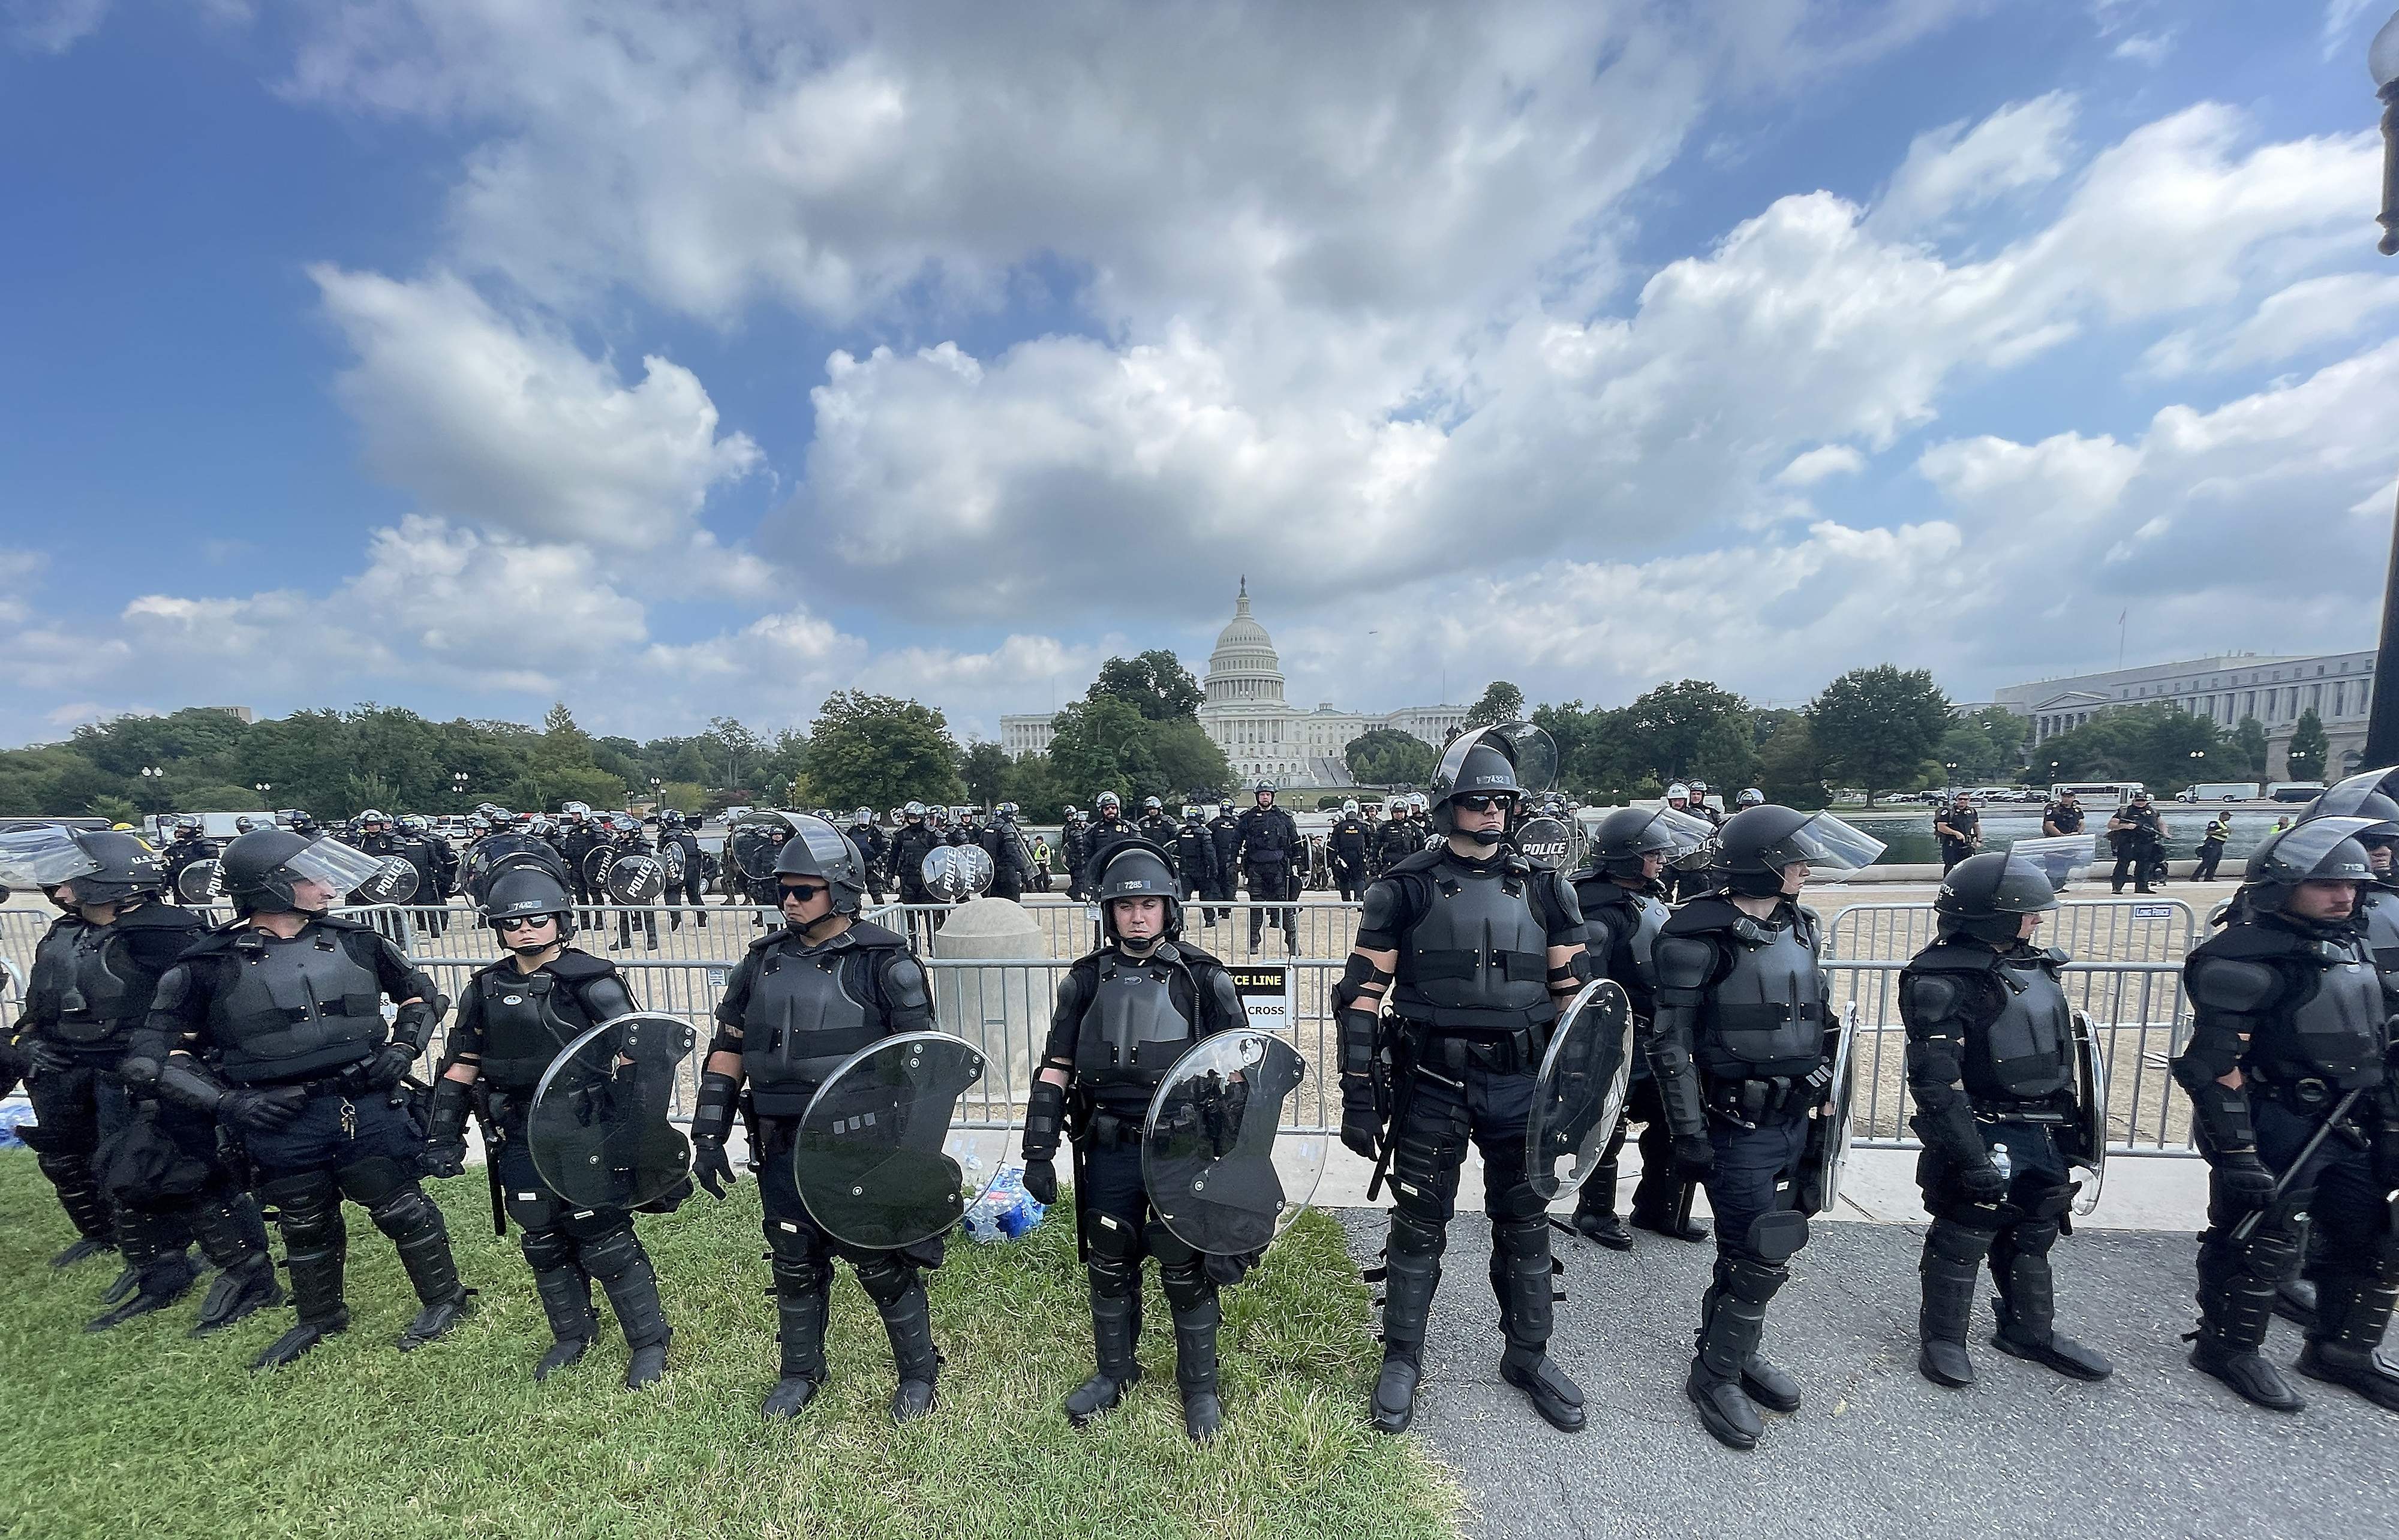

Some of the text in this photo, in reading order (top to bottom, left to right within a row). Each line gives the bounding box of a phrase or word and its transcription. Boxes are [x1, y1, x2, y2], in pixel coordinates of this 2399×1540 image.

[1522, 843, 1567, 855] POLICE
[375, 859, 407, 897] POLICE
[596, 850, 613, 884] POLICE
[626, 859, 654, 898] POLICE
[943, 849, 957, 892] POLICE
[964, 850, 977, 891] POLICE
[1125, 880, 1143, 889] 7285
[514, 901, 533, 911] 7442
[1252, 976, 1281, 985] LINE
[1247, 1006, 1284, 1015] CROSS
